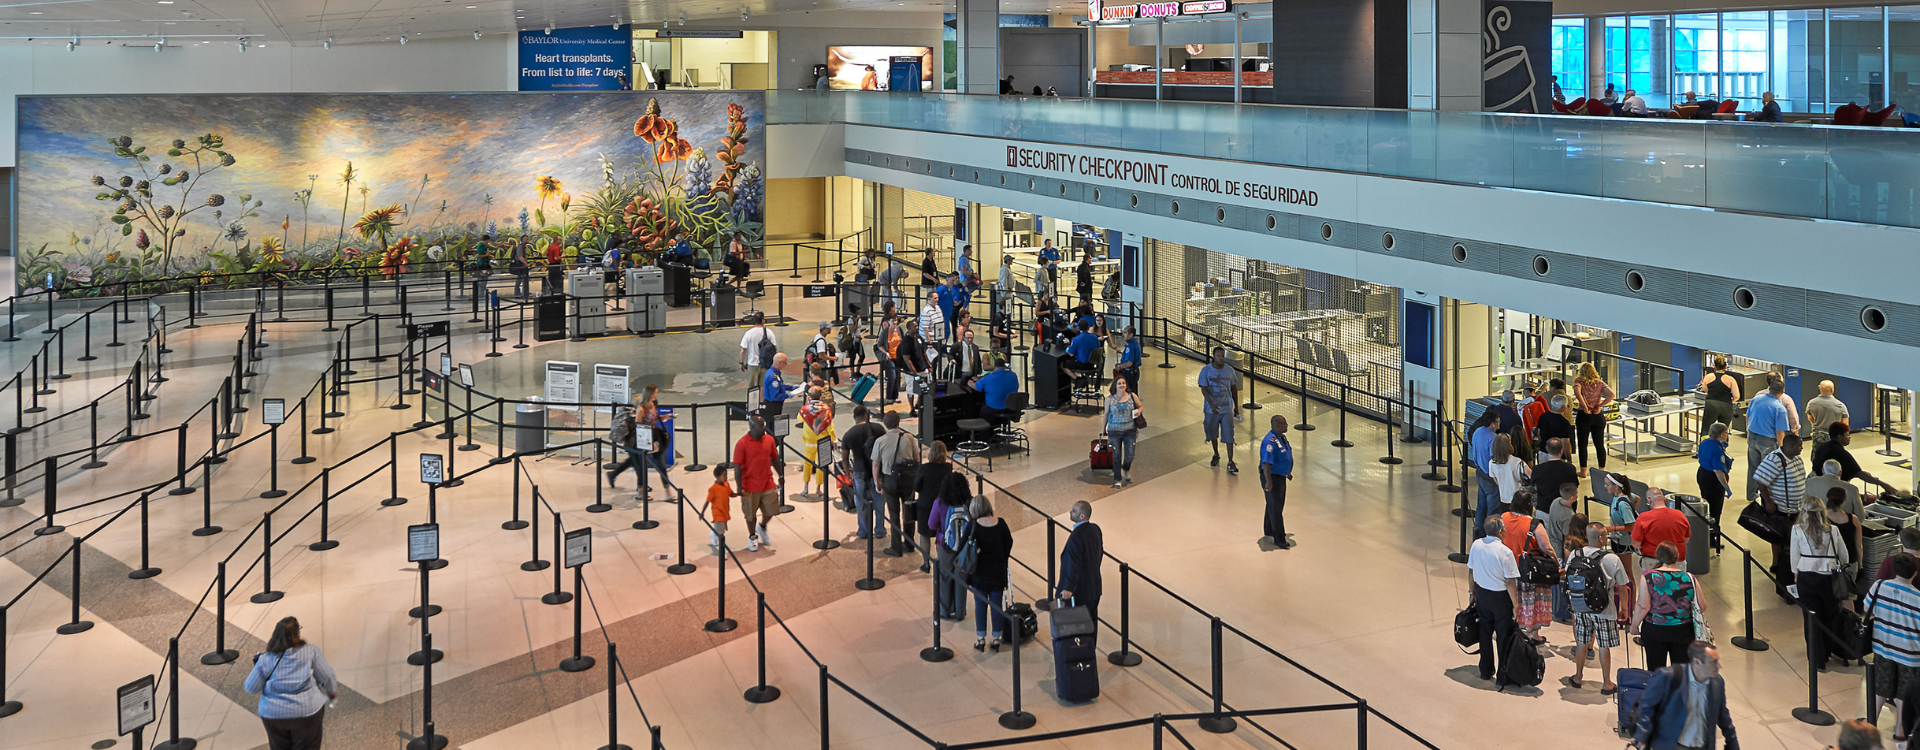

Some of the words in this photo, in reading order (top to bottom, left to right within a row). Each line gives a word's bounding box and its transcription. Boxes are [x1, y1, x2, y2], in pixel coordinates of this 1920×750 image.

[1103, 6, 1136, 18] DUNKIN'
[1141, 4, 1177, 16] DONUTS
[535, 54, 560, 62] Heart
[562, 54, 614, 63] transplants.
[522, 68, 546, 77] From
[548, 68, 563, 77] list
[565, 68, 574, 77] to
[577, 68, 593, 77] life:
[595, 68, 601, 77] 7
[1019, 148, 1077, 174] SECURITY
[1079, 155, 1169, 186] CHECKPOINT
[1171, 172, 1223, 194] CONTROL
[1225, 180, 1241, 197] DE
[1243, 182, 1318, 207] SEGURIDAD
